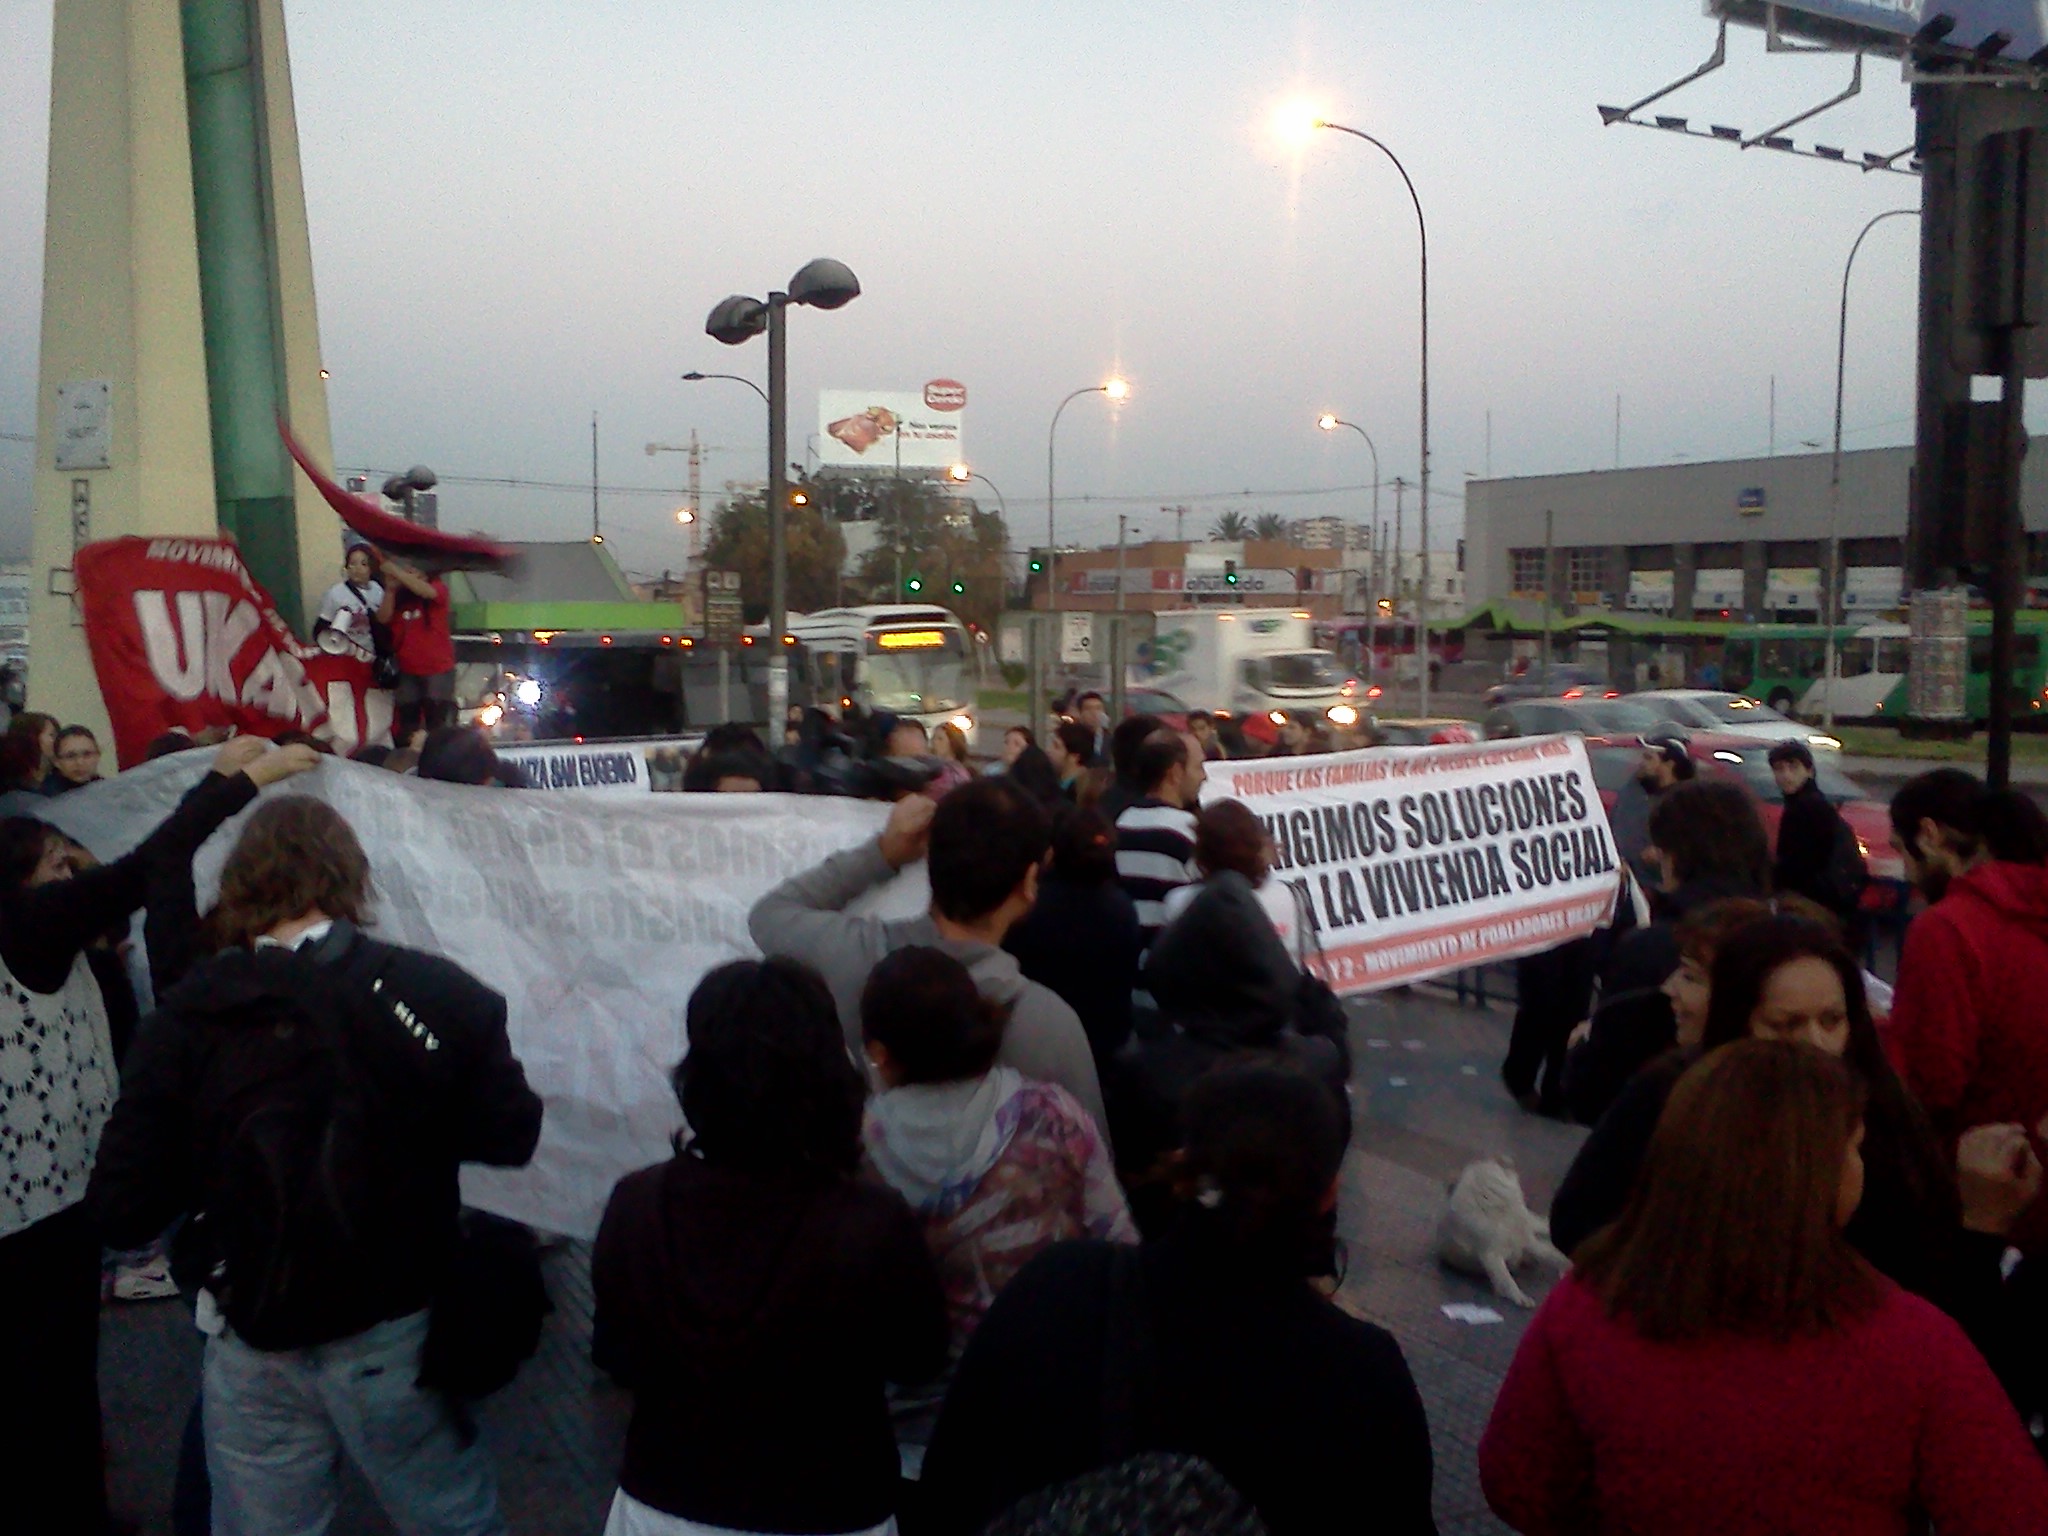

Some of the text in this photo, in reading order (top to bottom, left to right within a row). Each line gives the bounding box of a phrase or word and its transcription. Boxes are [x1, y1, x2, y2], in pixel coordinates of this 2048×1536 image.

[1232, 771, 1292, 797] PORQUE
[1258, 769, 1588, 871] XIGIMOS SOLUCIONES
[1319, 869, 1366, 928] LA
[1360, 842, 1512, 919] VIVIENDA
[1509, 823, 1615, 891] SOCIAL
